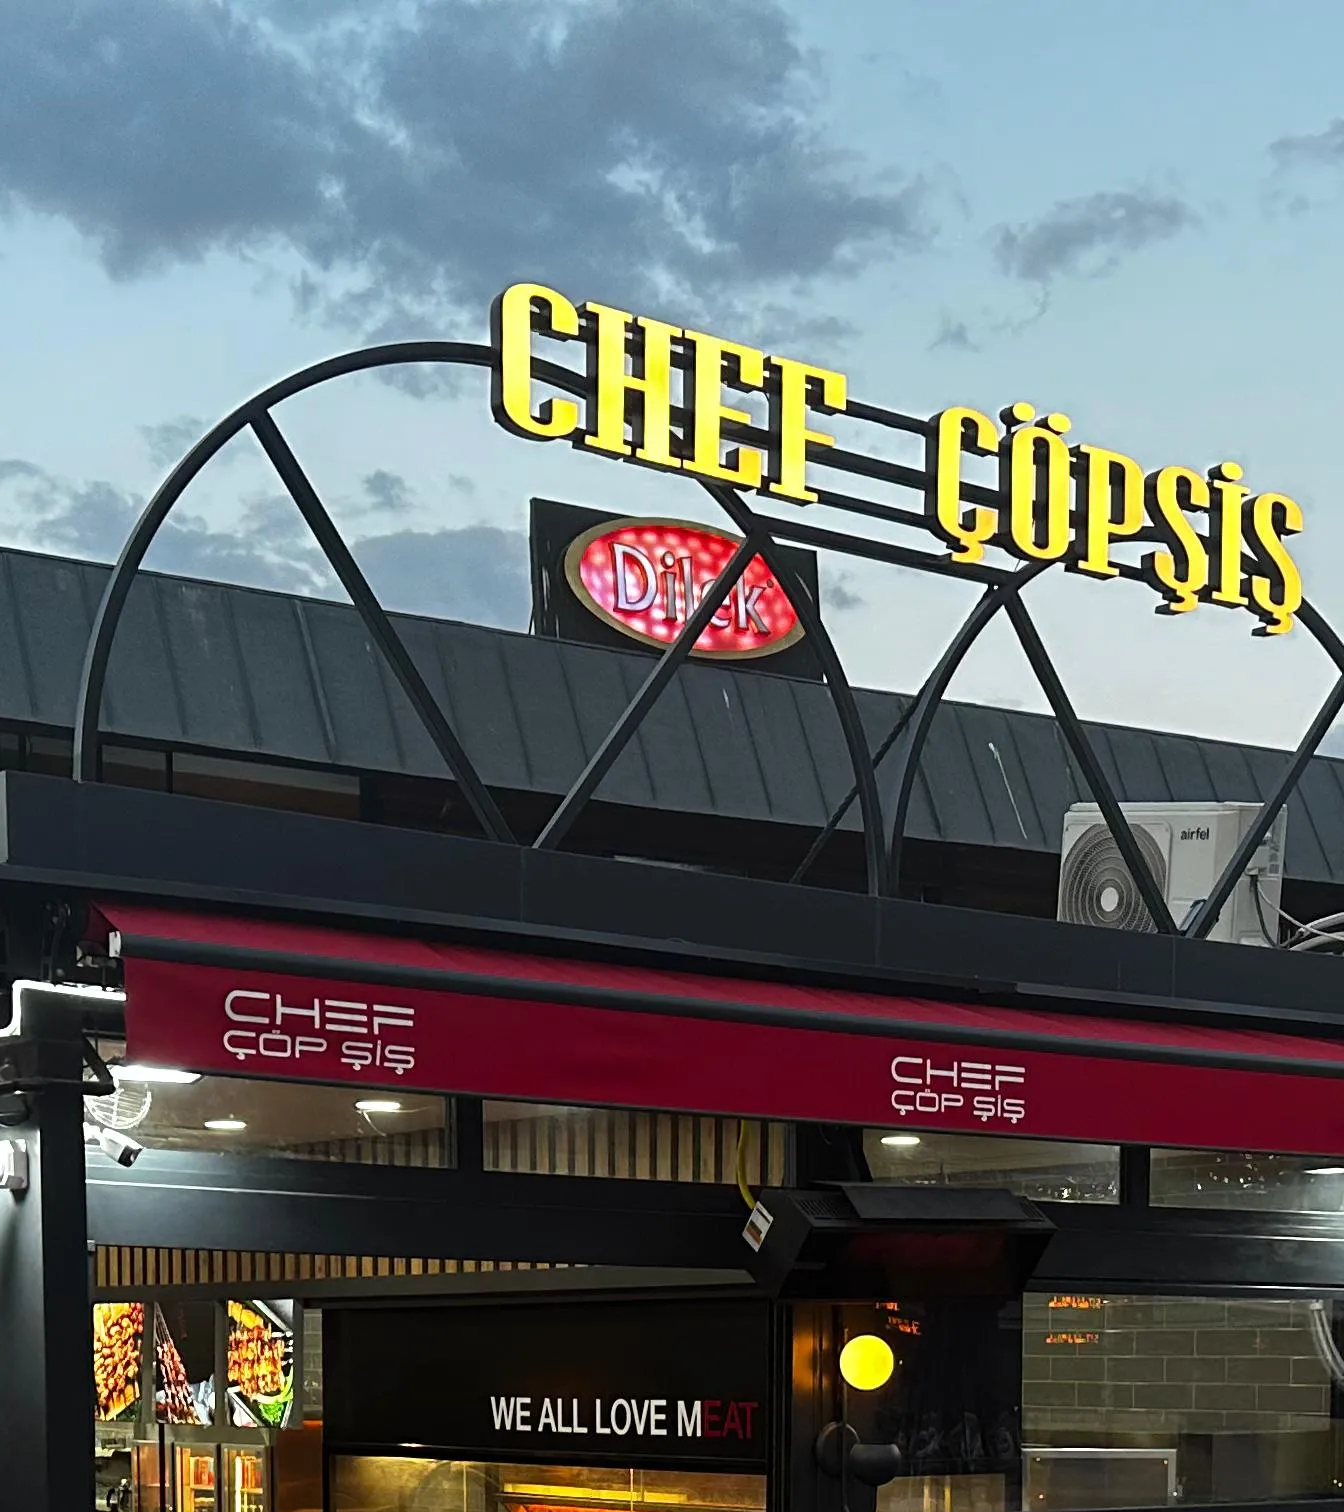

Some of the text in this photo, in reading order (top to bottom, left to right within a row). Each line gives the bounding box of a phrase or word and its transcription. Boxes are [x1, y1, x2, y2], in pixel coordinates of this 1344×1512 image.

[501, 281, 1304, 634] CHEF ÇÖPŞİŞ
[1180, 826, 1210, 840] airfel
[224, 989, 415, 1035] CHEF
[223, 1029, 328, 1061] ÇÖP
[891, 1056, 1026, 1091] CHEF
[891, 1088, 964, 1116] ÇÖP
[490, 1396, 759, 1439] WE ALL LOVE MEAT
